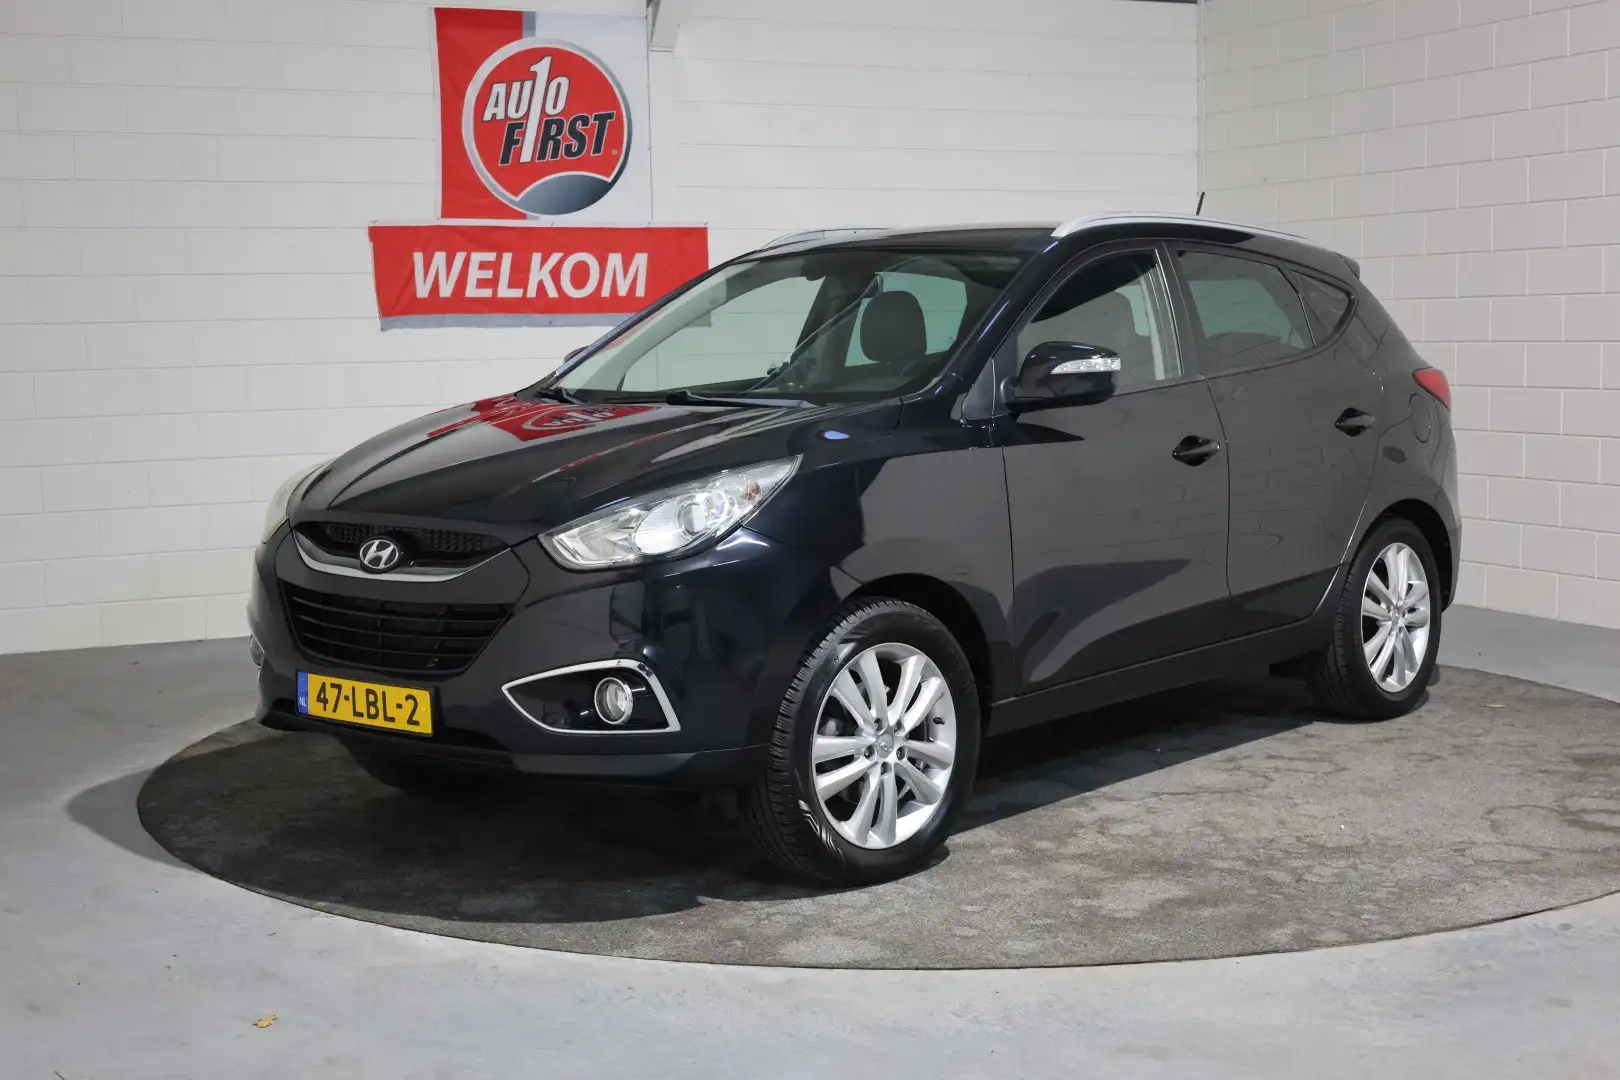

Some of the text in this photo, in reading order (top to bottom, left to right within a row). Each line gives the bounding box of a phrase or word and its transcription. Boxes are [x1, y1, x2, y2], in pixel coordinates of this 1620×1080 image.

[413, 252, 648, 298] WELKOM
[299, 696, 308, 707] NL
[316, 681, 420, 726] 47-LBL-2
